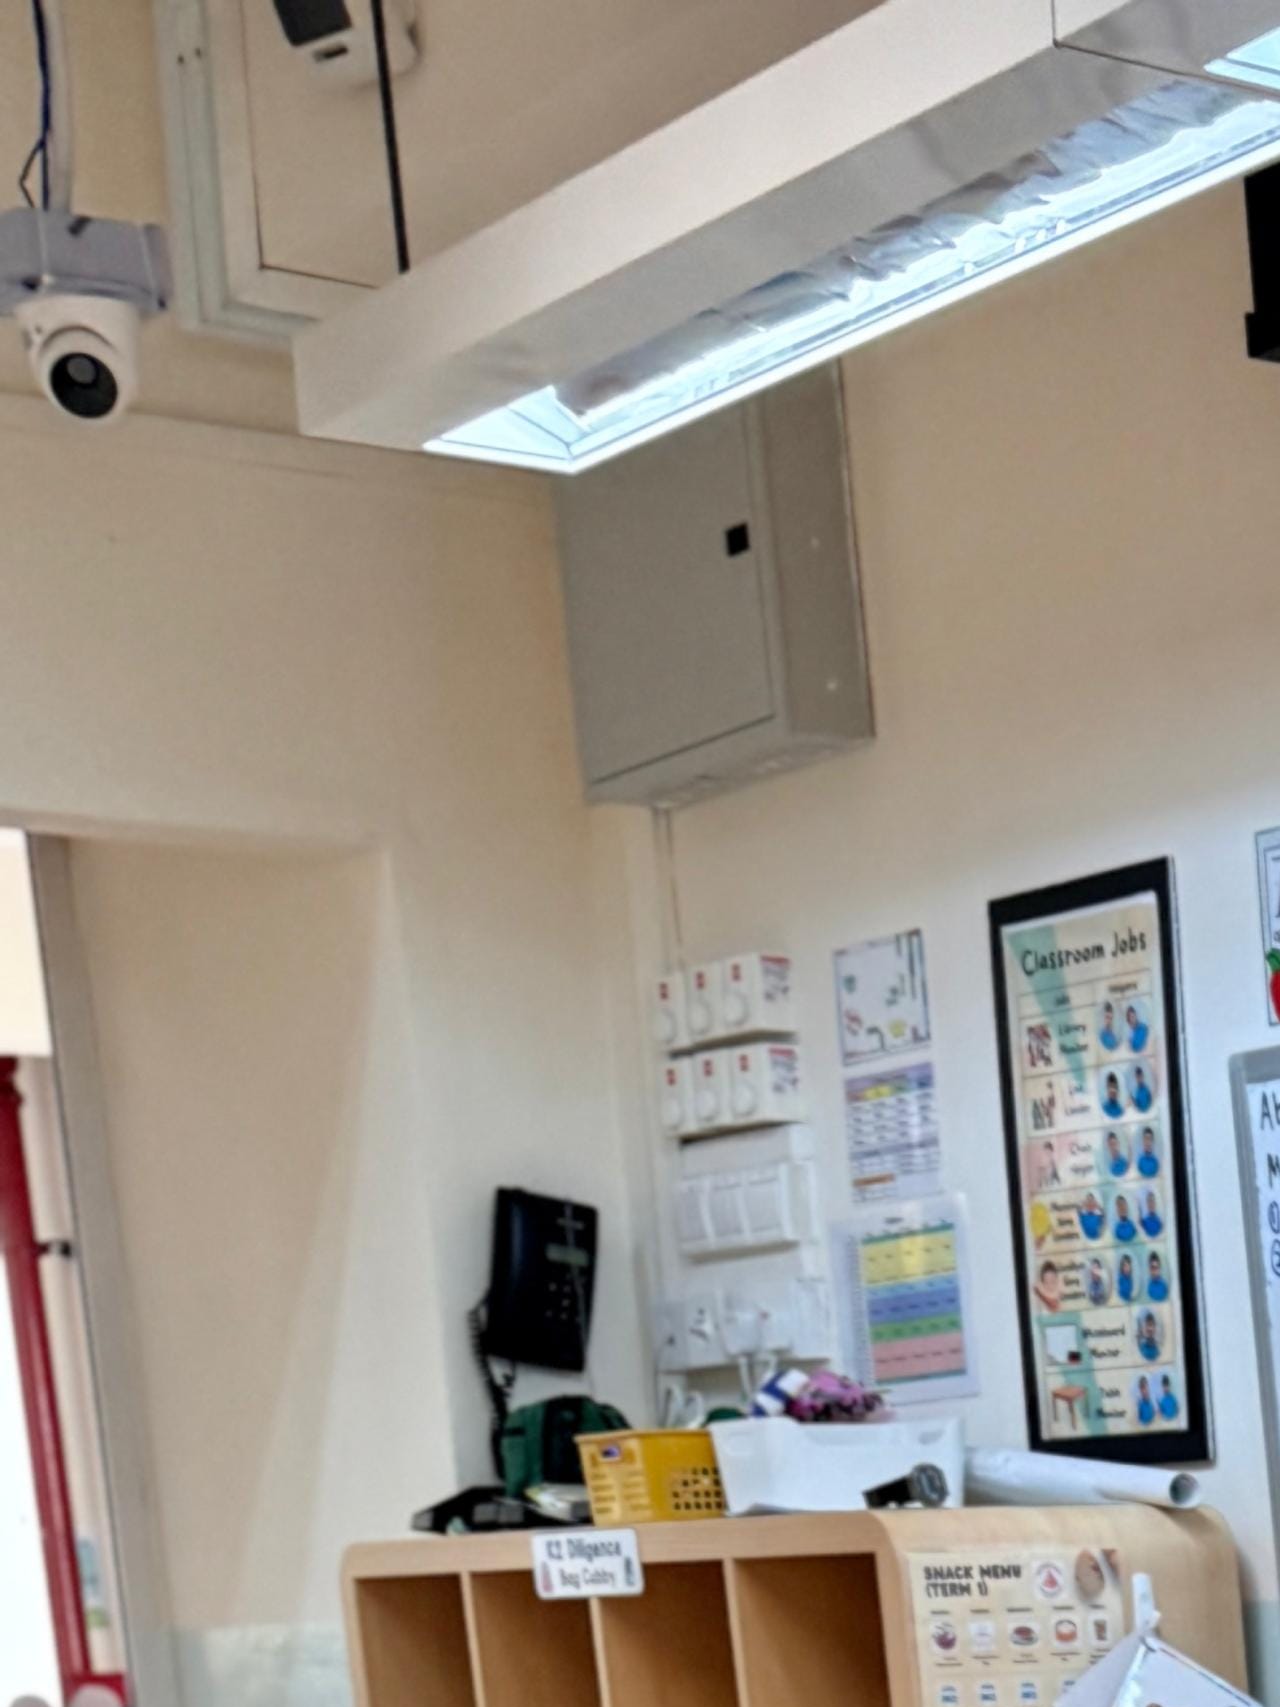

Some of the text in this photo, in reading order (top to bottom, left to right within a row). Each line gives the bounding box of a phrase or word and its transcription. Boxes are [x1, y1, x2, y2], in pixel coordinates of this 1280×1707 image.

[1021, 928, 1147, 977] Classroom Jobs
[924, 1564, 1022, 1581] SNACK MENU
[926, 1581, 972, 1598] (TERM
